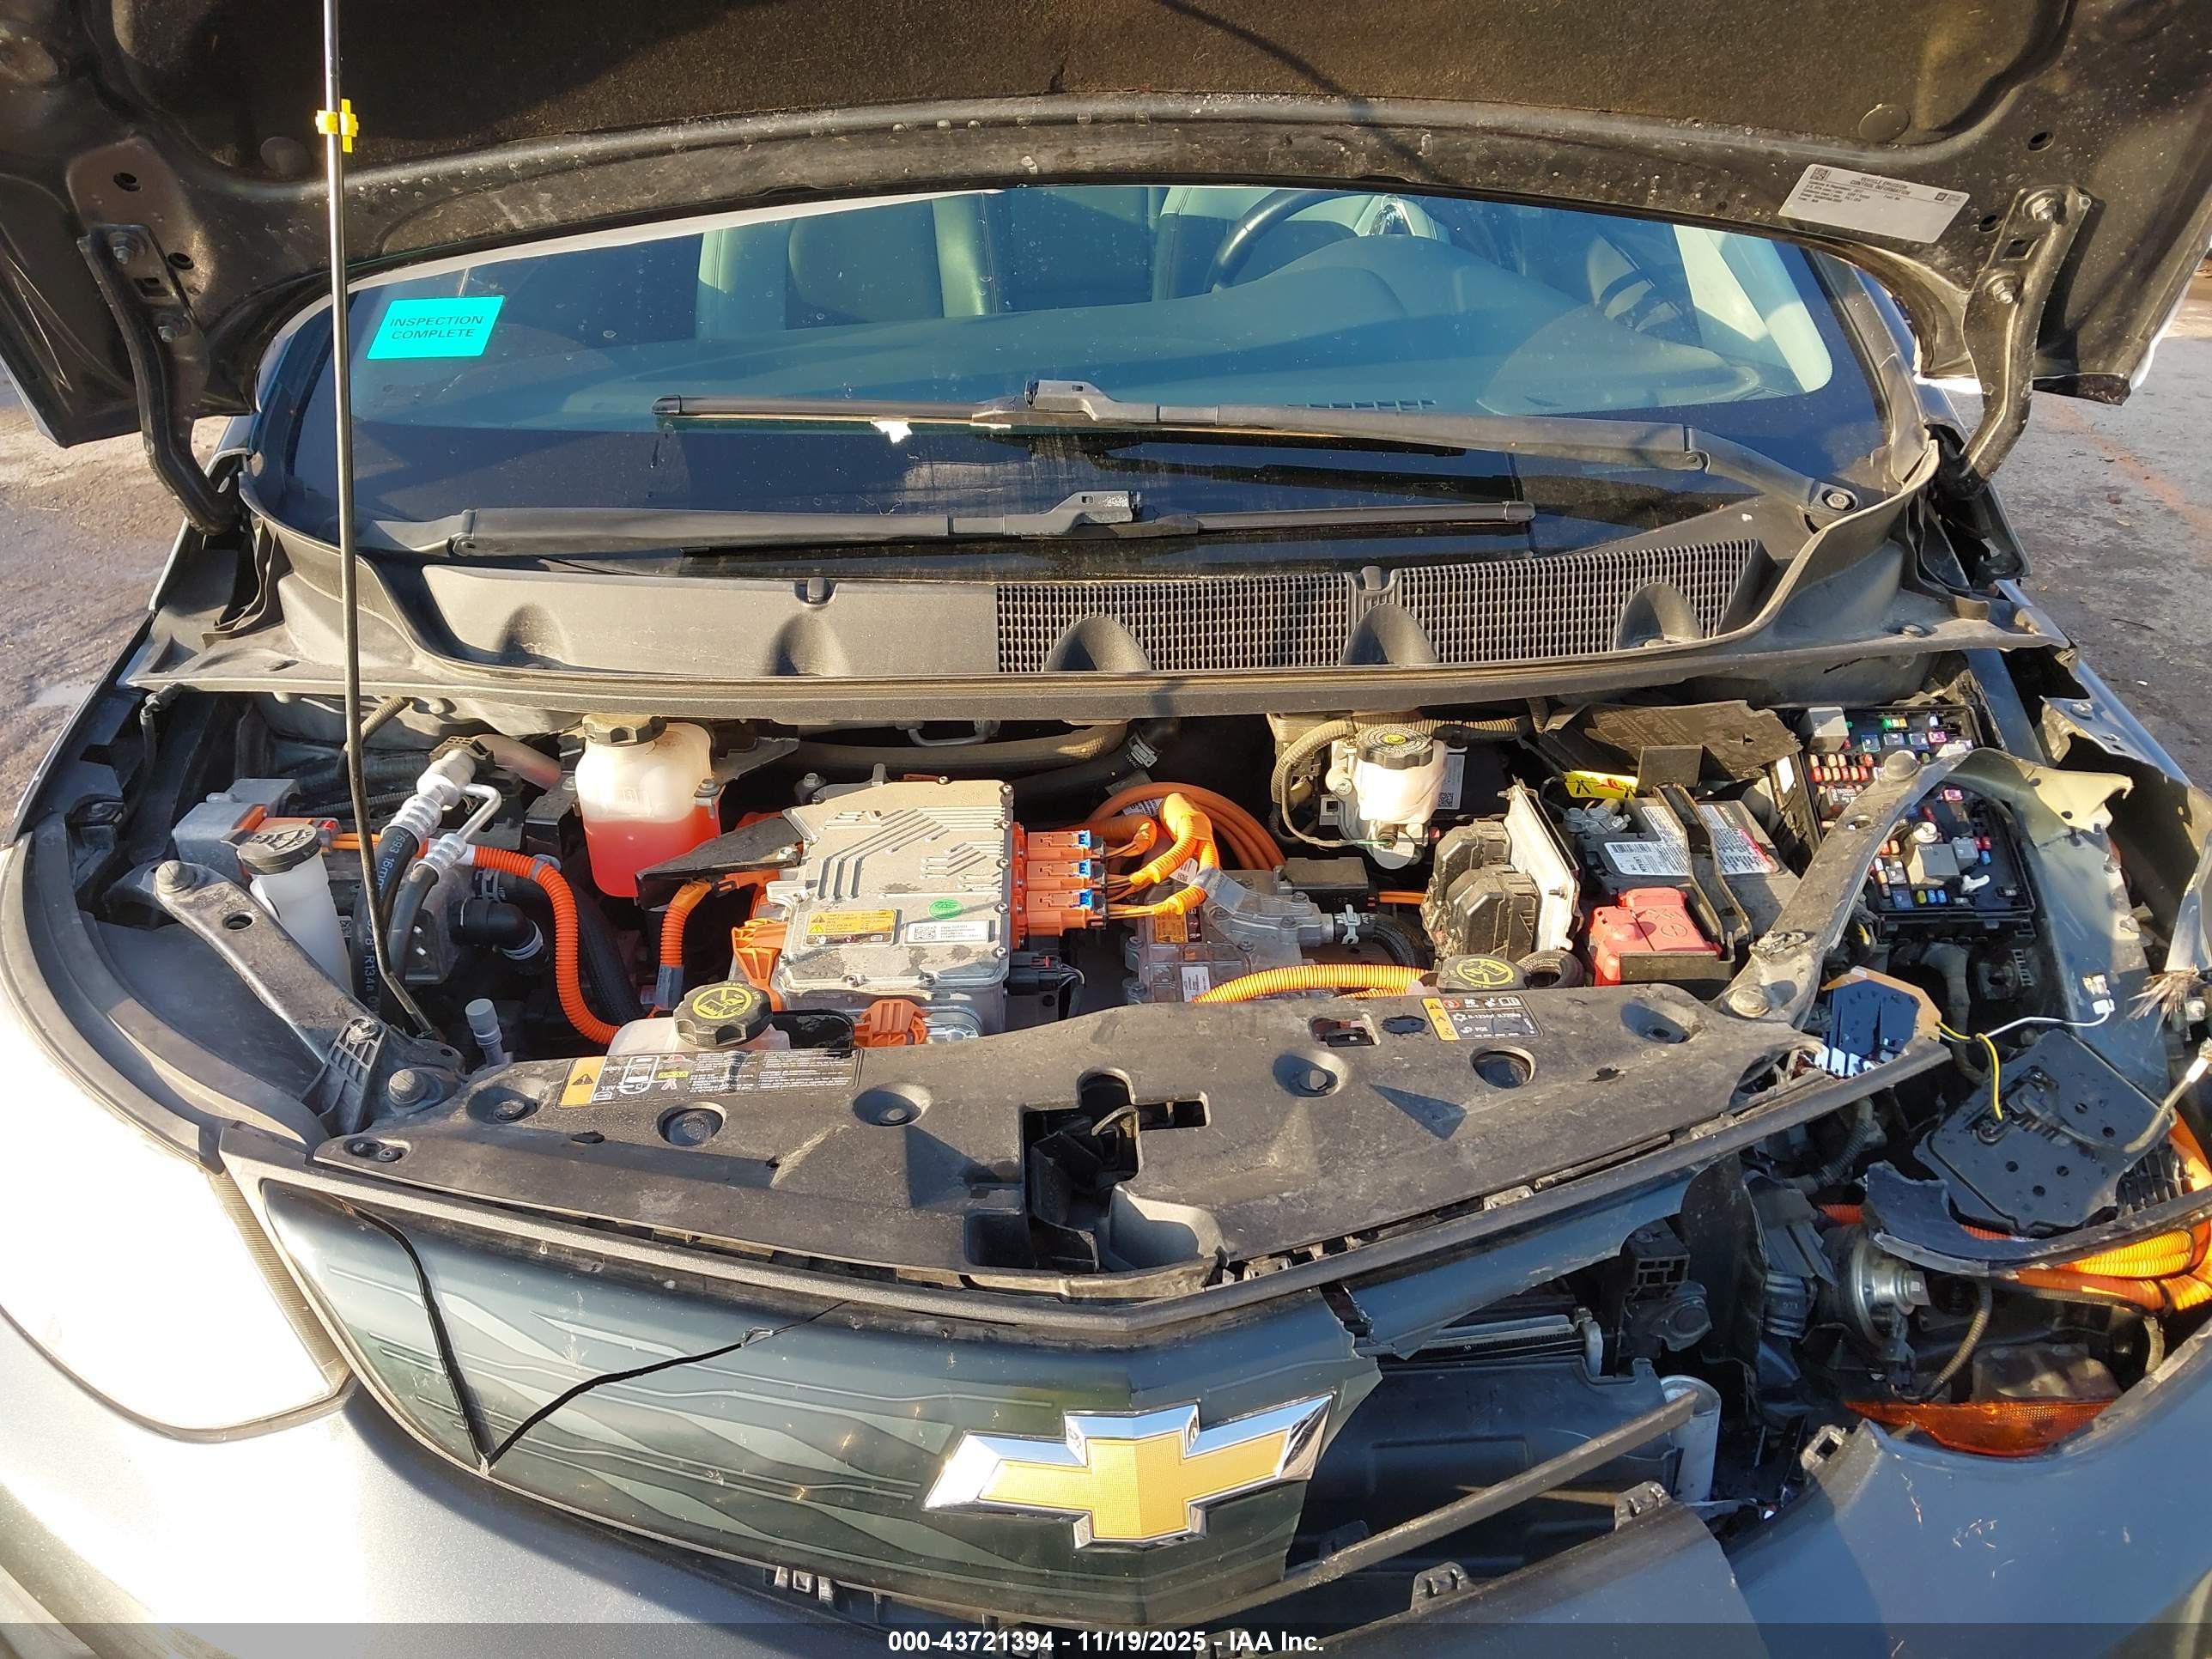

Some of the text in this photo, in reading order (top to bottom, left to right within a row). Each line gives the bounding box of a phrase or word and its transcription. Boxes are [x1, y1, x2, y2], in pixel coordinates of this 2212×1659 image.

[390, 315, 483, 327] INSPECTION
[392, 328, 475, 339] COMPLETE
[389, 830, 410, 854] 7693
